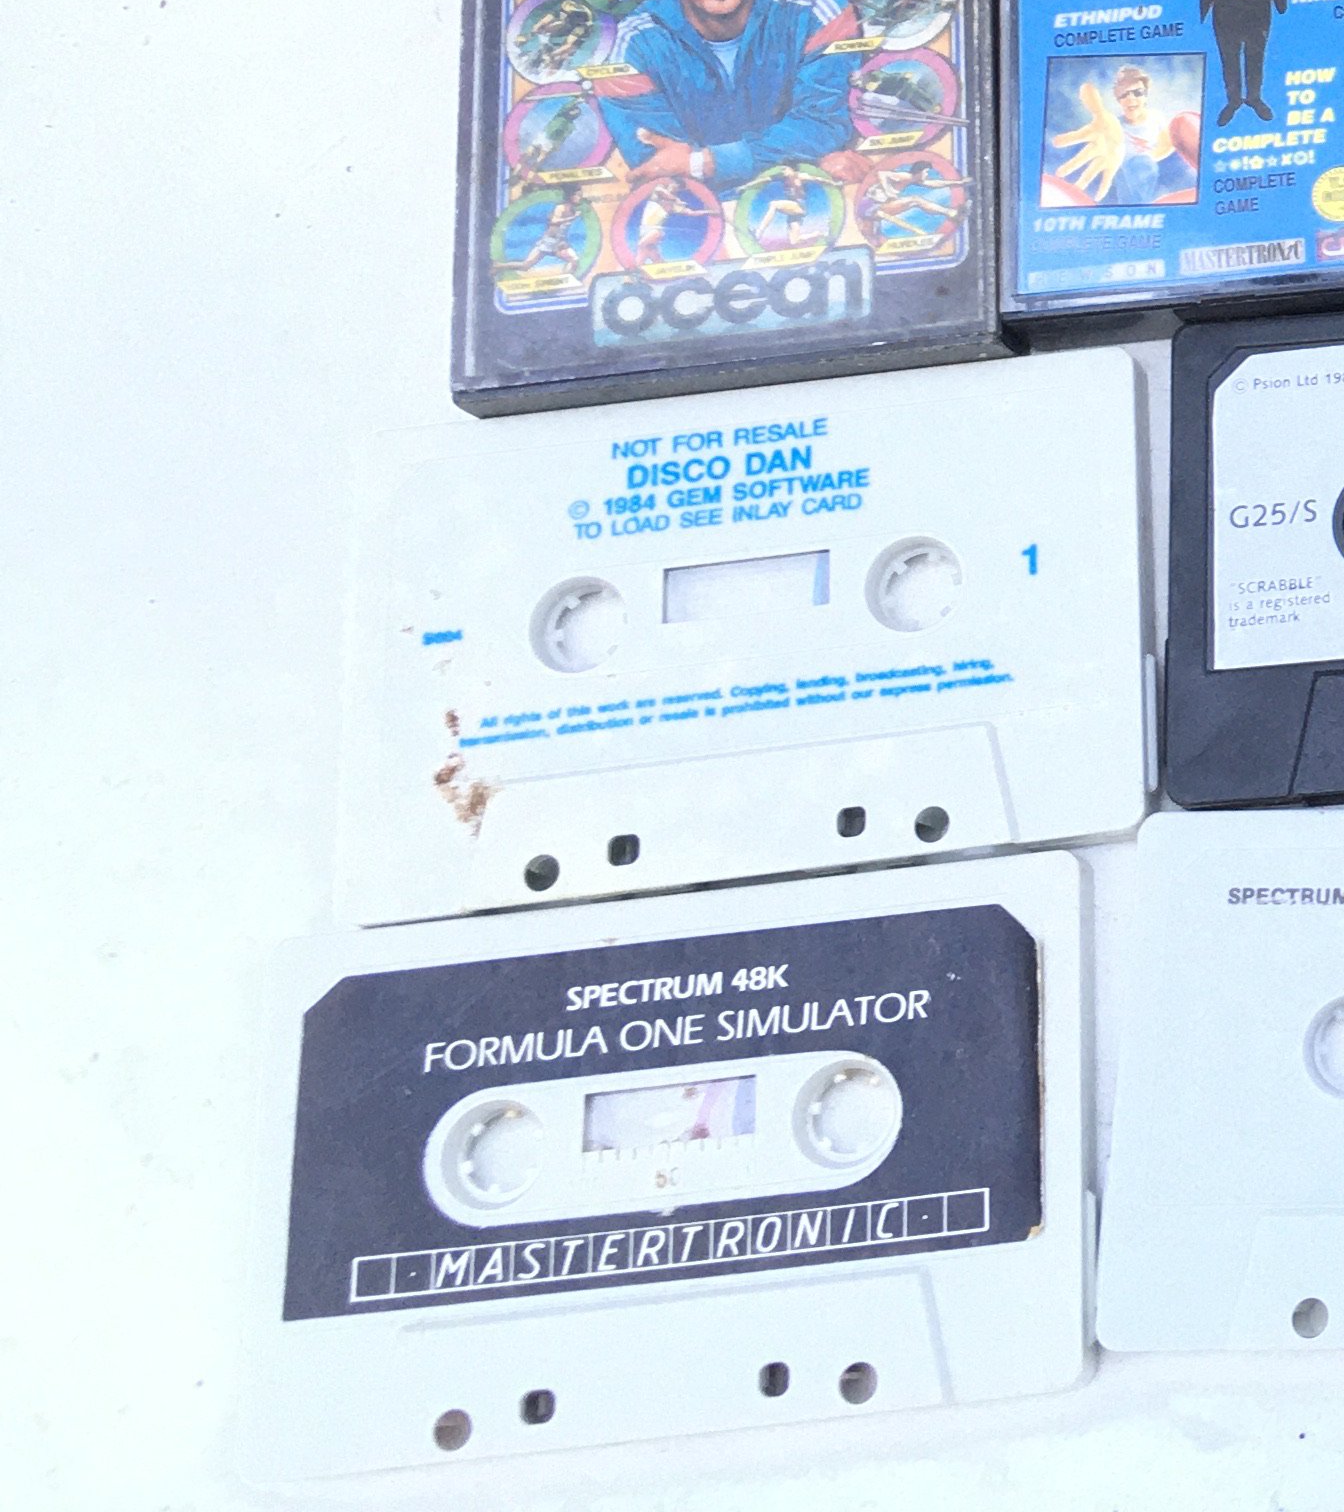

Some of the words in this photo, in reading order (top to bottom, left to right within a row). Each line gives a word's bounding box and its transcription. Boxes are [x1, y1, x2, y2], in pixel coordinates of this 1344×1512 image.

[626, 455, 731, 489] DISCO
[745, 446, 812, 475] DAN
[603, 493, 656, 515] 1984
[667, 486, 723, 509] GEM
[733, 468, 870, 502] SOFTWARE
[1229, 500, 1318, 529] G25/S
[1021, 544, 1039, 574] 1
[566, 970, 723, 1012] SPECTRUM
[731, 964, 789, 993] 48K
[423, 1030, 608, 1073] FORMULA
[621, 1019, 704, 1052] ONE
[717, 989, 930, 1043] SIMULATOR
[435, 1198, 902, 1289] MASTERTRONIC
